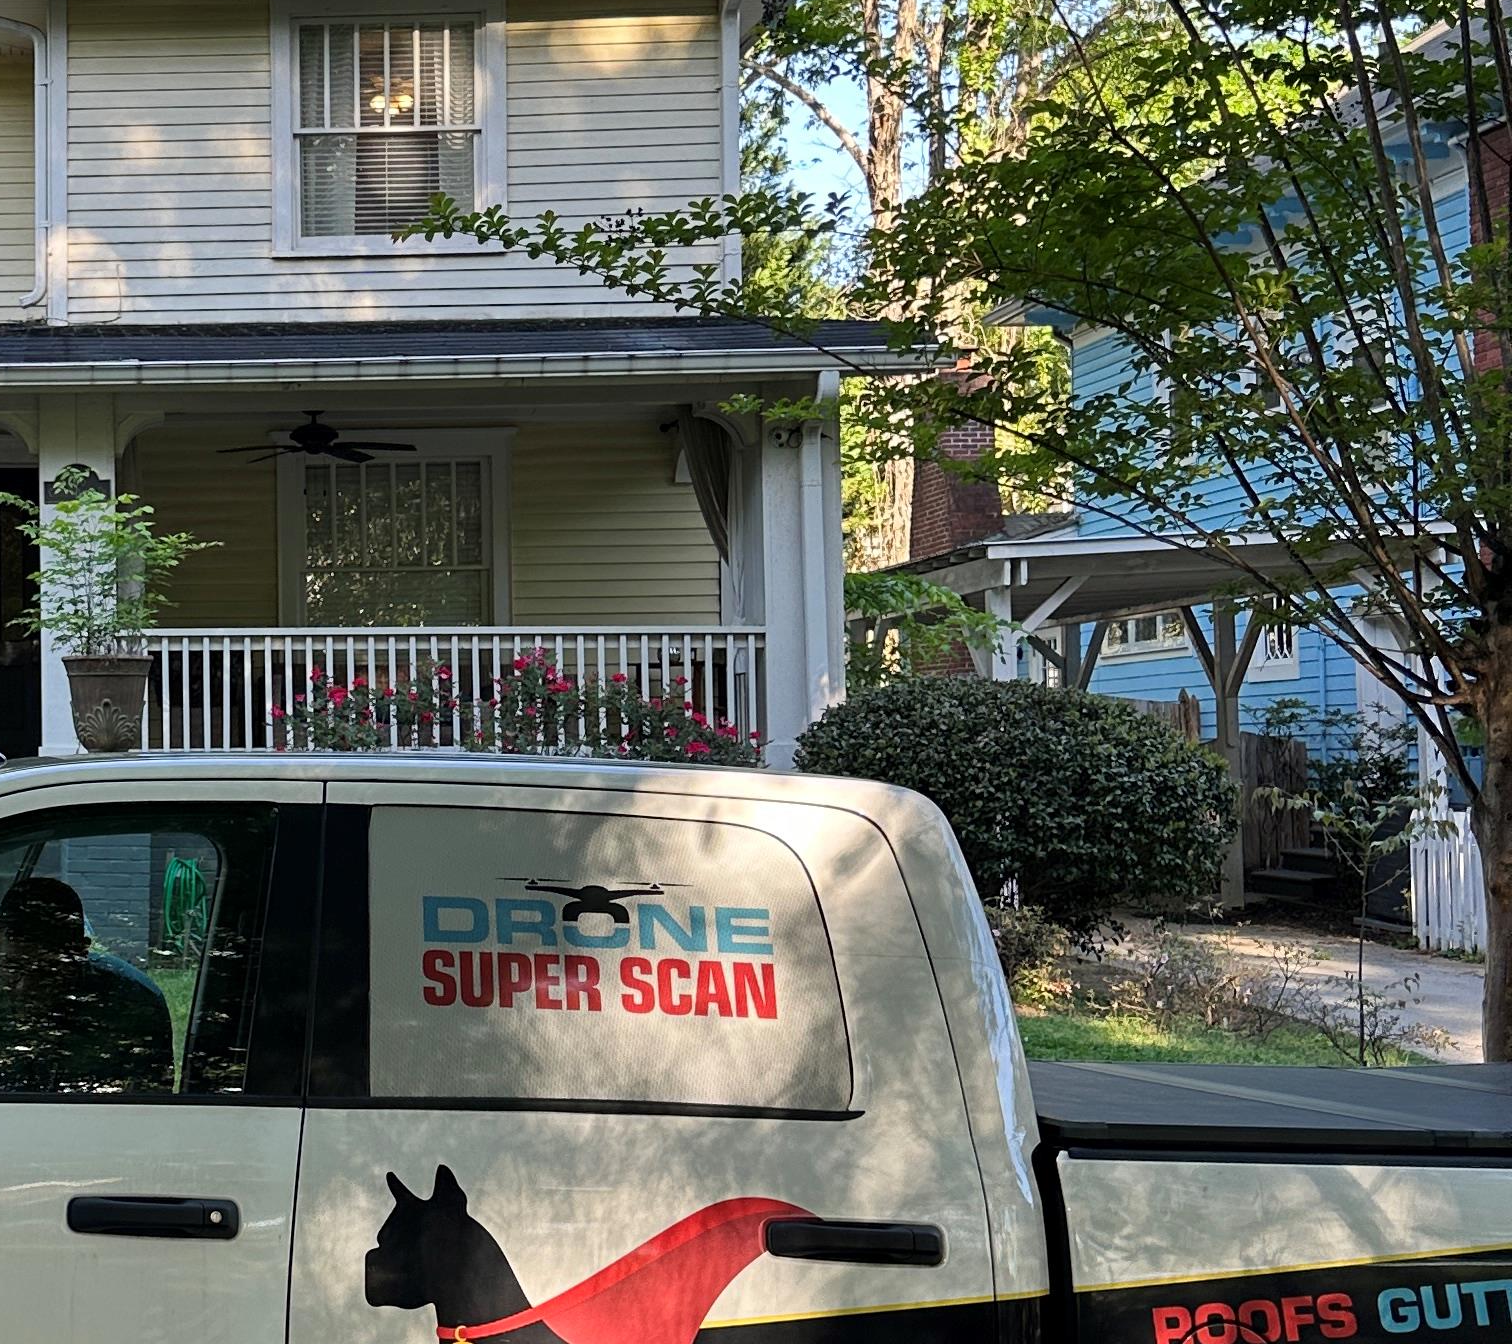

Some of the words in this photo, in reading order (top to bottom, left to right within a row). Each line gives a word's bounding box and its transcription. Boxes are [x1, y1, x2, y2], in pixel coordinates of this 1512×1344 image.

[422, 896, 774, 954] DRONE
[422, 950, 602, 1011] SUPER
[620, 957, 778, 1019] SCAN
